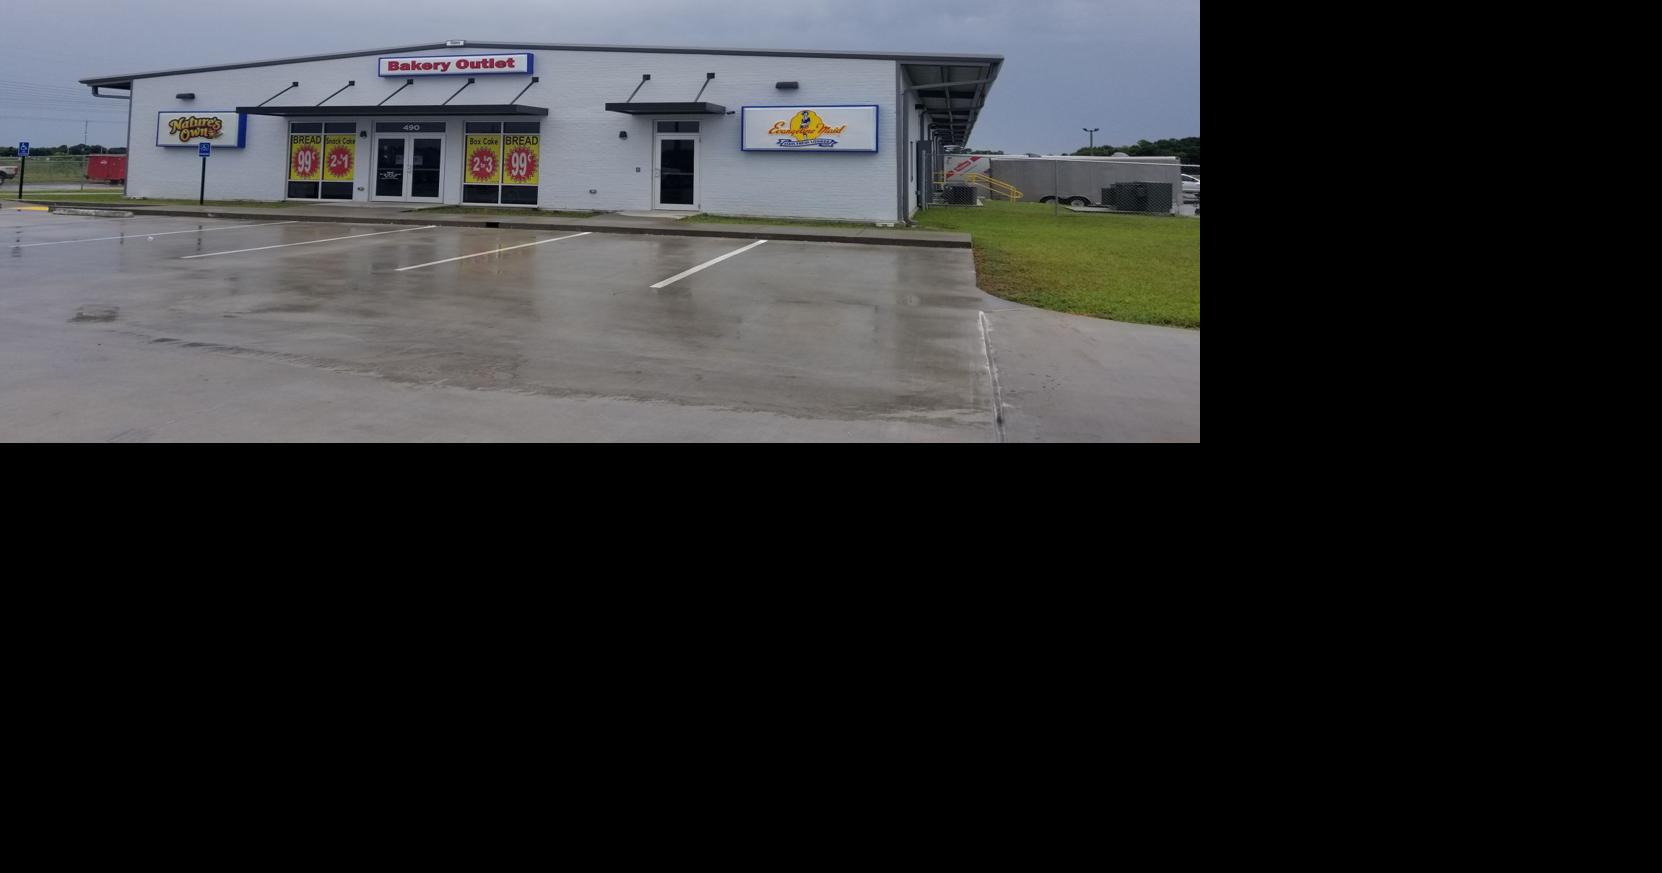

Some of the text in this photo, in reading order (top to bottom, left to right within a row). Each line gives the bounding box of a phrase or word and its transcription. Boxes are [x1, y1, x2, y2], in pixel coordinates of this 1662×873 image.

[387, 57, 515, 72] Bakery Outlet
[168, 116, 222, 134] Nature's
[179, 128, 208, 142] Own
[293, 135, 321, 144] BREAD
[505, 136, 539, 145] BREAD
[469, 137, 498, 145] Box Cake
